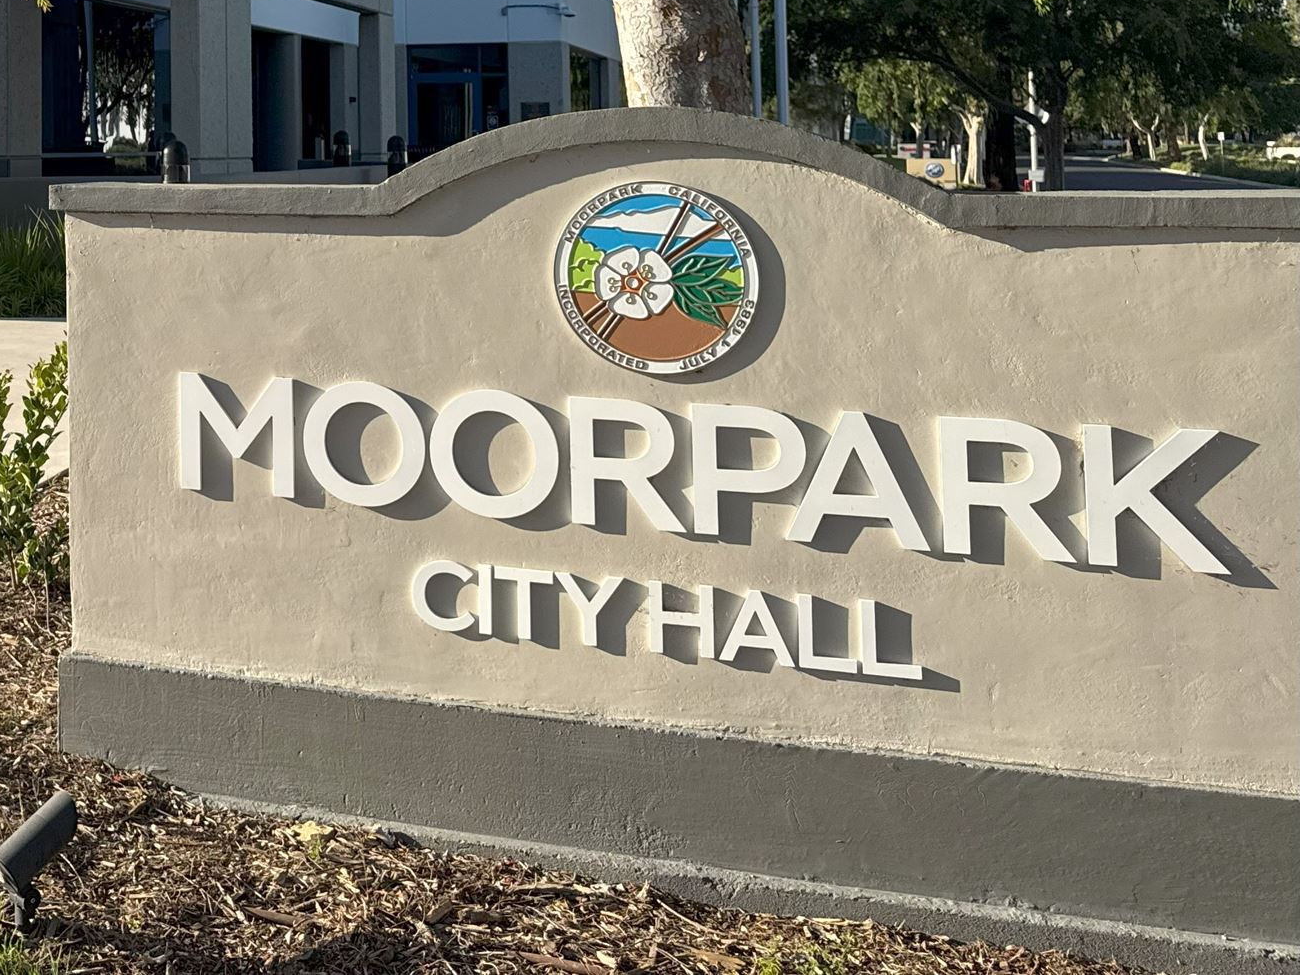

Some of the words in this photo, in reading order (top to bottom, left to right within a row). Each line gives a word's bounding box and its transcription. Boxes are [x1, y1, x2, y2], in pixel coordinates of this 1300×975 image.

[564, 184, 643, 244] MOORPARK
[668, 186, 752, 259] CALIFORNIA
[558, 283, 649, 371] INCORPORATED
[679, 347, 718, 371] JULY
[732, 299, 756, 337] 1983
[179, 371, 1230, 576] MOORPARK
[411, 559, 625, 647] CITY
[648, 580, 923, 681] HALL
